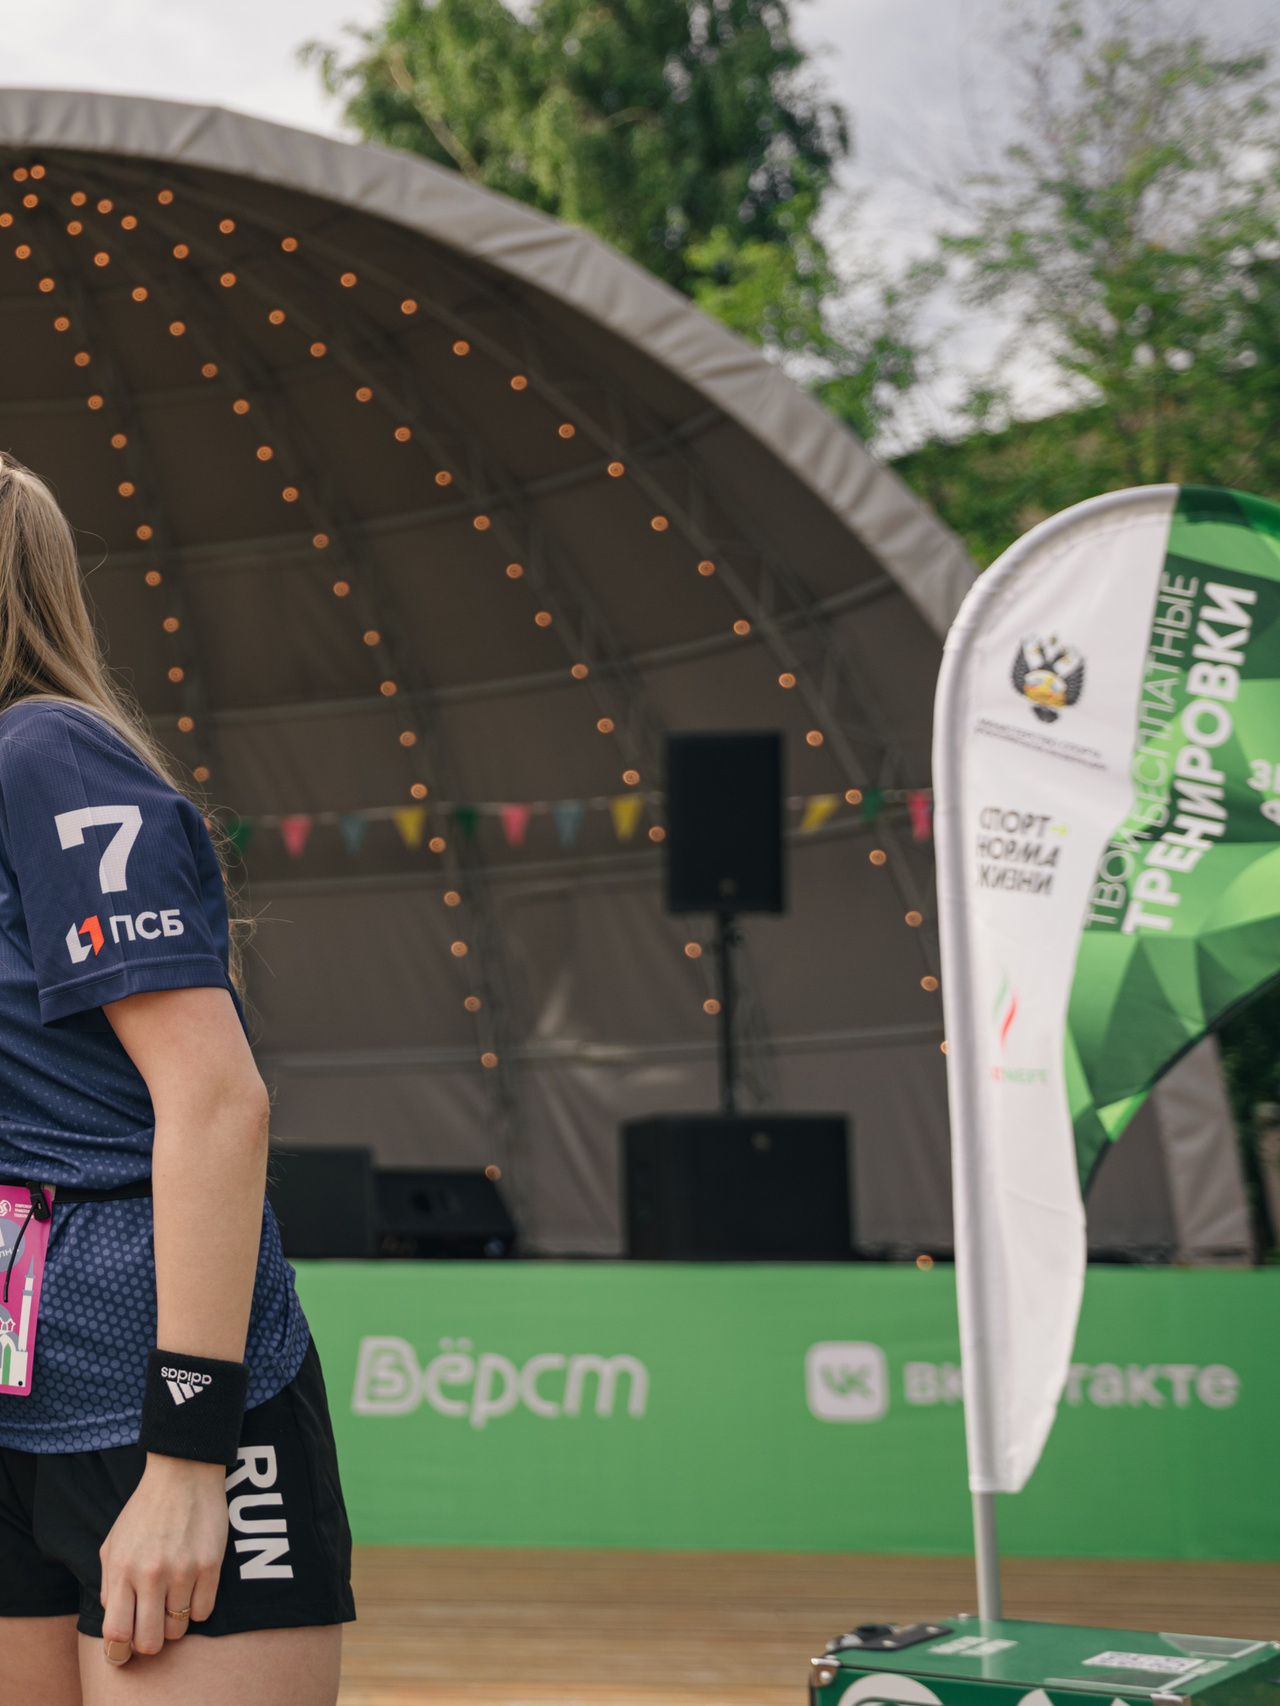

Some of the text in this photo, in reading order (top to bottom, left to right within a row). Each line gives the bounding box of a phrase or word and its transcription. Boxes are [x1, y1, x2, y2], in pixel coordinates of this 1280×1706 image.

[1121, 581, 1258, 936] ТРЕНИРОВКИ
[979, 806, 1052, 838] СПОРТ
[54, 805, 143, 894] 7
[109, 909, 184, 944] ПСБ
[161, 1366, 212, 1386] adidas
[902, 1361, 1241, 1409] вктакте
[225, 1445, 294, 1580] RUN
